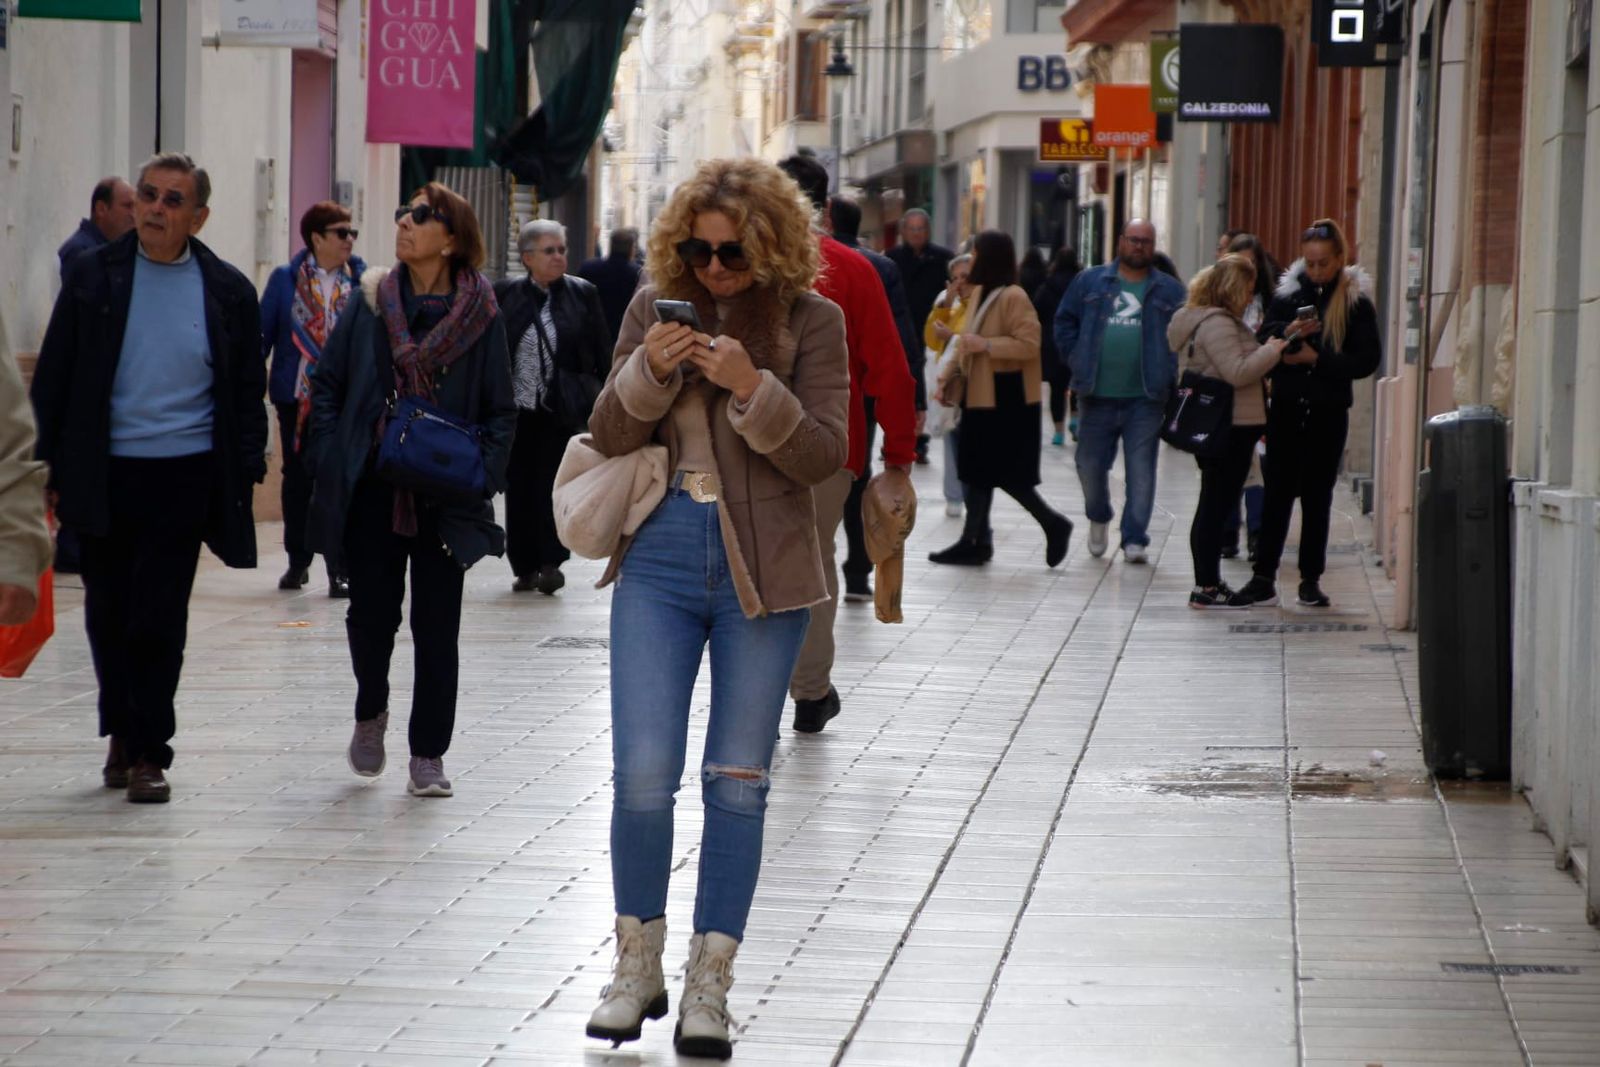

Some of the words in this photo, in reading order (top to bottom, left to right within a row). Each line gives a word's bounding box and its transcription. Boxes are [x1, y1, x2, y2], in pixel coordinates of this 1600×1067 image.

[379, 56, 461, 89] GUA
[1018, 54, 1084, 92] BB
[1182, 102, 1271, 115] CALZEDONIA
[1096, 131, 1149, 145] orange
[1043, 143, 1105, 154] TABACOS
